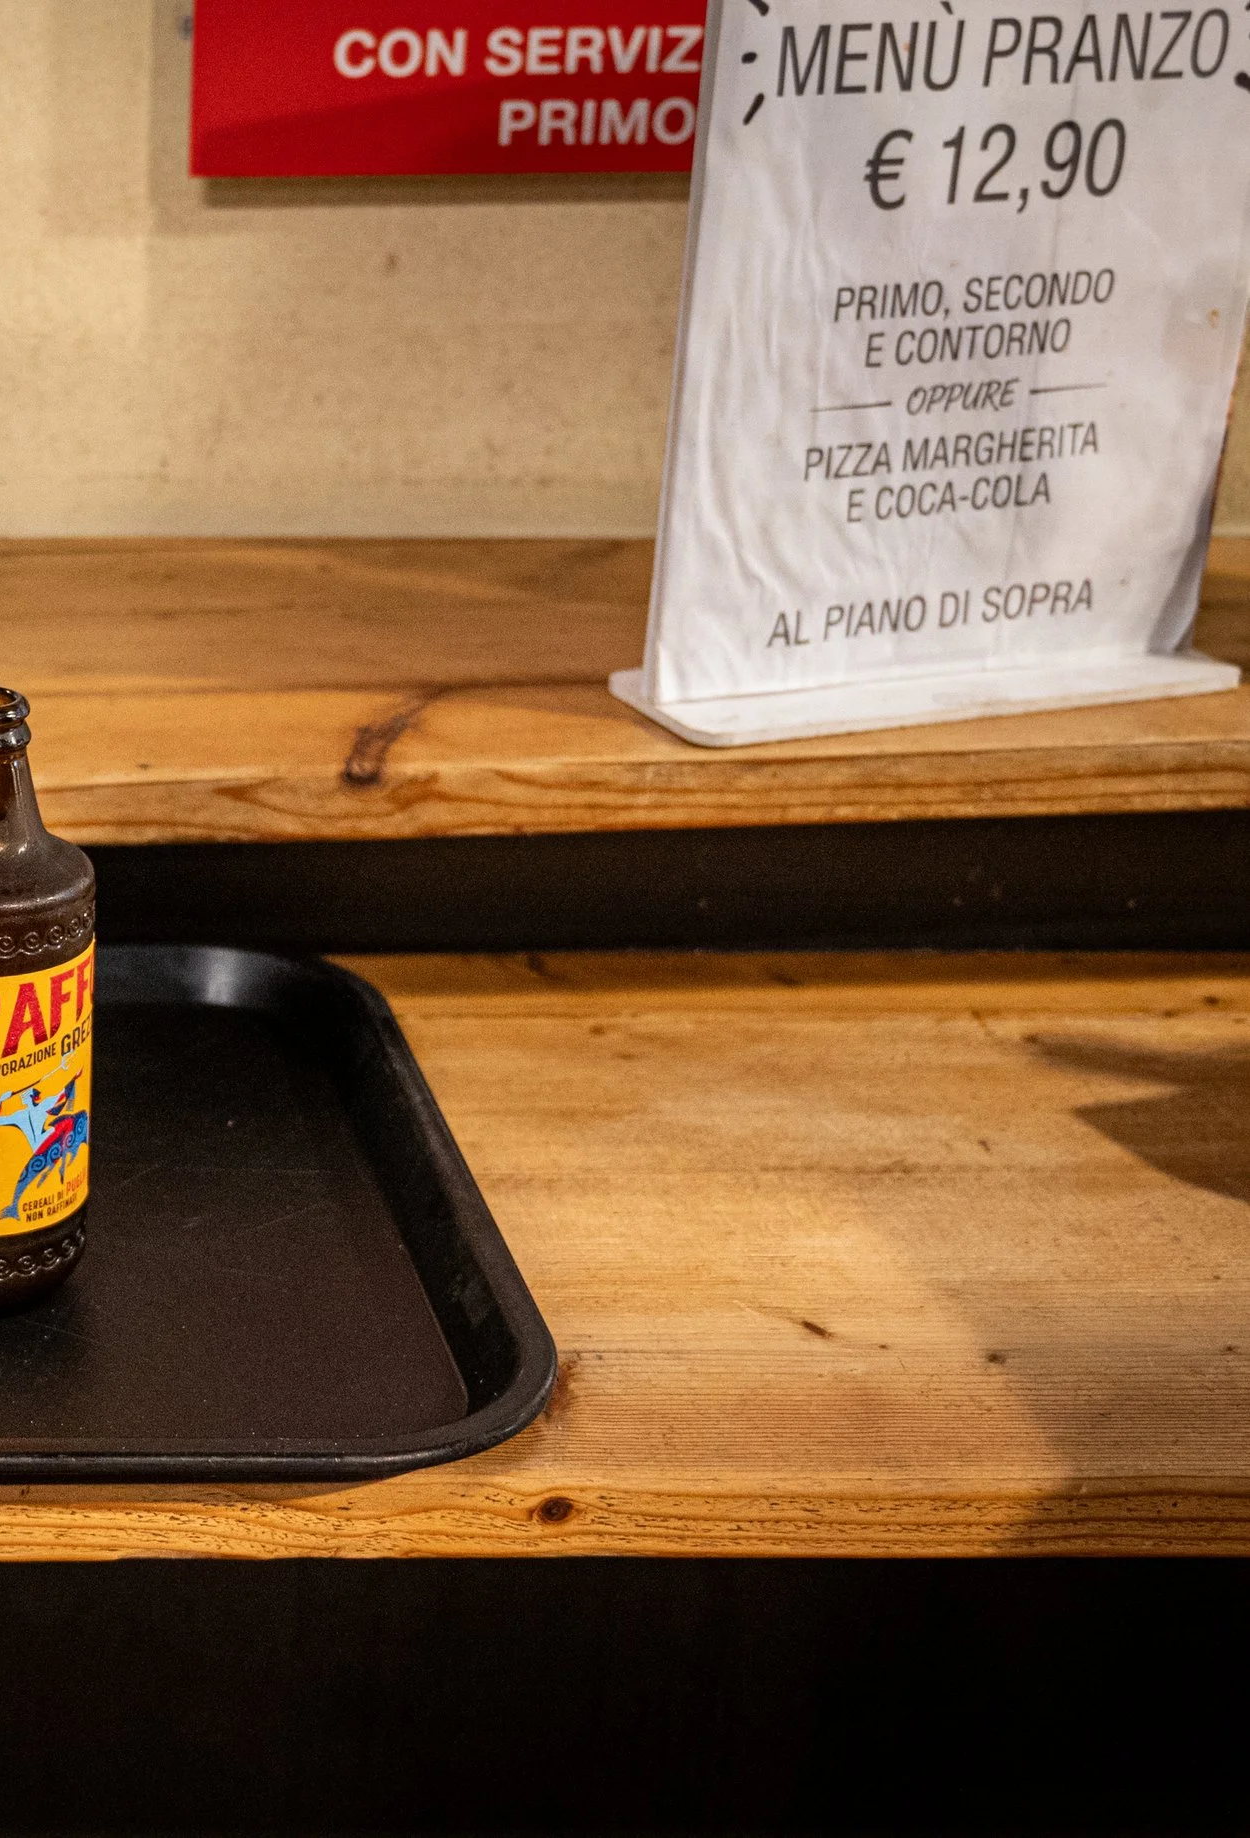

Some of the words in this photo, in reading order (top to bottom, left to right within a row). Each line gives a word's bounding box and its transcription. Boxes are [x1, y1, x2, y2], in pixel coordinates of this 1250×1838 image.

[333, 28, 467, 79] CON
[775, 1, 964, 97] MENÙ
[982, 8, 1229, 87] PRANZO
[498, 97, 696, 146] PRIMO
[864, 129, 913, 211] €
[942, 118, 1126, 214] 12,90
[834, 280, 950, 322] PRIMO,
[963, 268, 1115, 313] SECONDO
[865, 332, 885, 368] E
[895, 318, 1071, 365] CONTORNO
[906, 378, 1021, 417] OPPURE
[804, 441, 891, 481] PIZZA
[902, 421, 1100, 472] MARGHERITA
[847, 488, 865, 523] E
[875, 474, 1051, 520] COCA-COLA
[766, 612, 811, 648] AL
[823, 593, 926, 641] PIANO
[938, 590, 970, 628] DI
[981, 579, 1094, 624] SOPRA
[25, 1212, 44, 1223] NON
